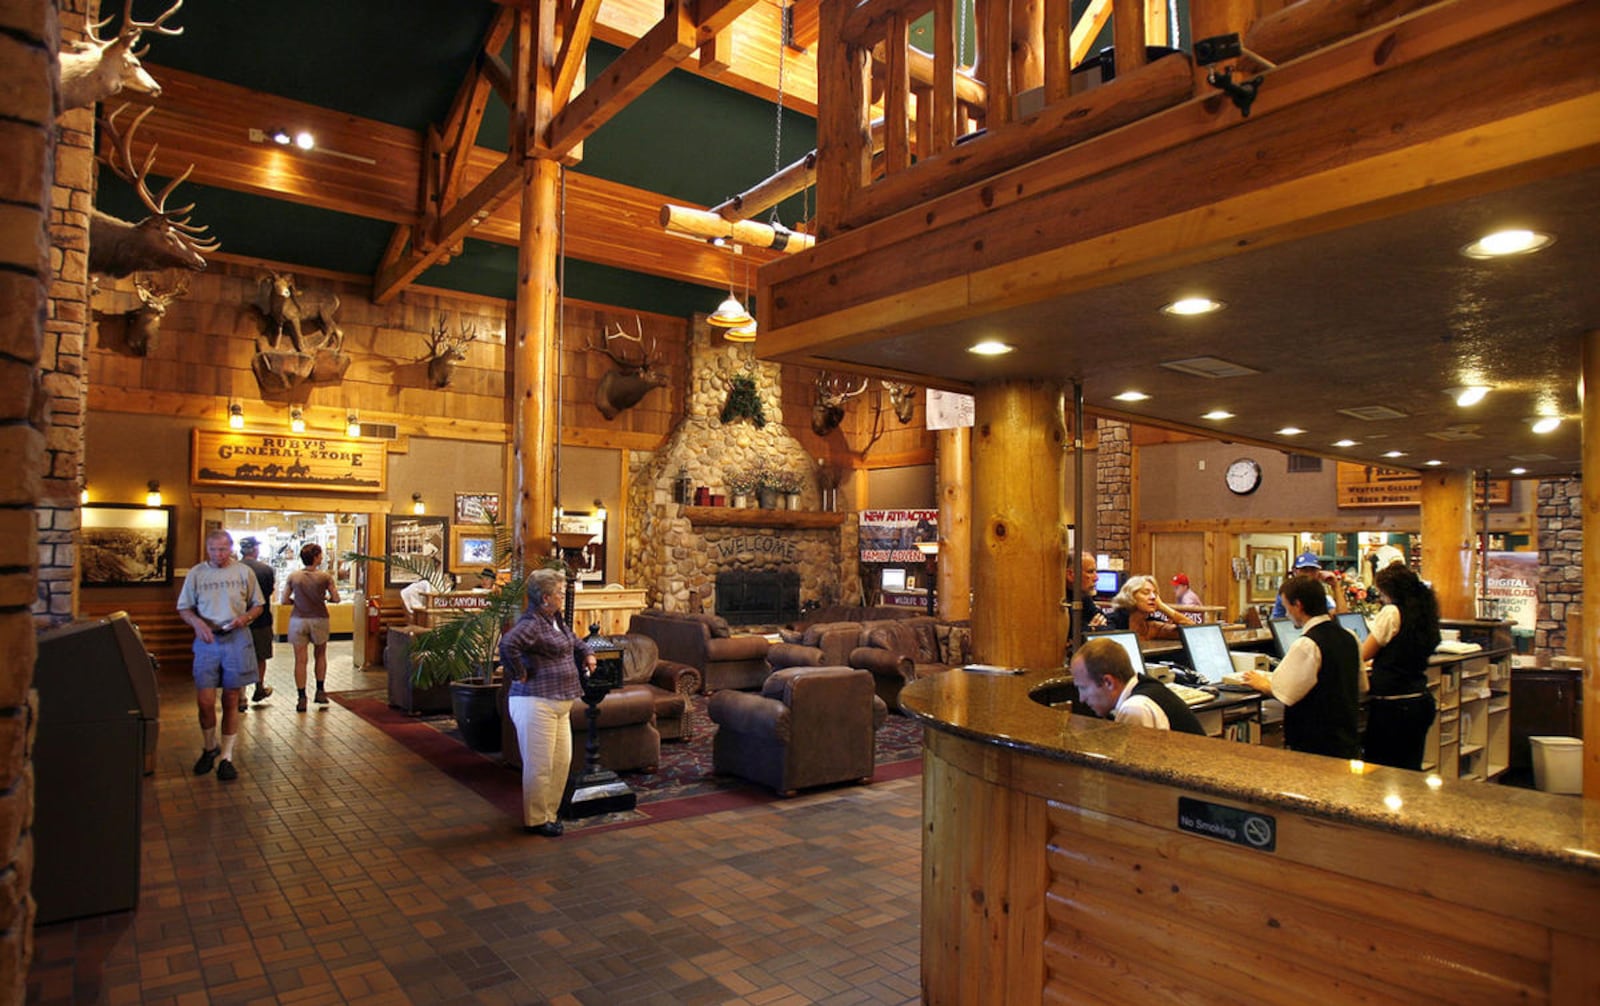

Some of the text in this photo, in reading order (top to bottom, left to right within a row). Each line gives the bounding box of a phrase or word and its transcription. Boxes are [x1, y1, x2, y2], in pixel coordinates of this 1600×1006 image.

[263, 438, 326, 450] RUBY'S
[218, 445, 363, 466] GENERAL STORE
[864, 511, 885, 521] NEW
[717, 536, 797, 559] WELCOME
[862, 551, 889, 562] FAMILY
[1487, 578, 1529, 587] DIGITAL
[449, 597, 477, 607] CANYON
[1181, 816, 1237, 839] No Smoking
